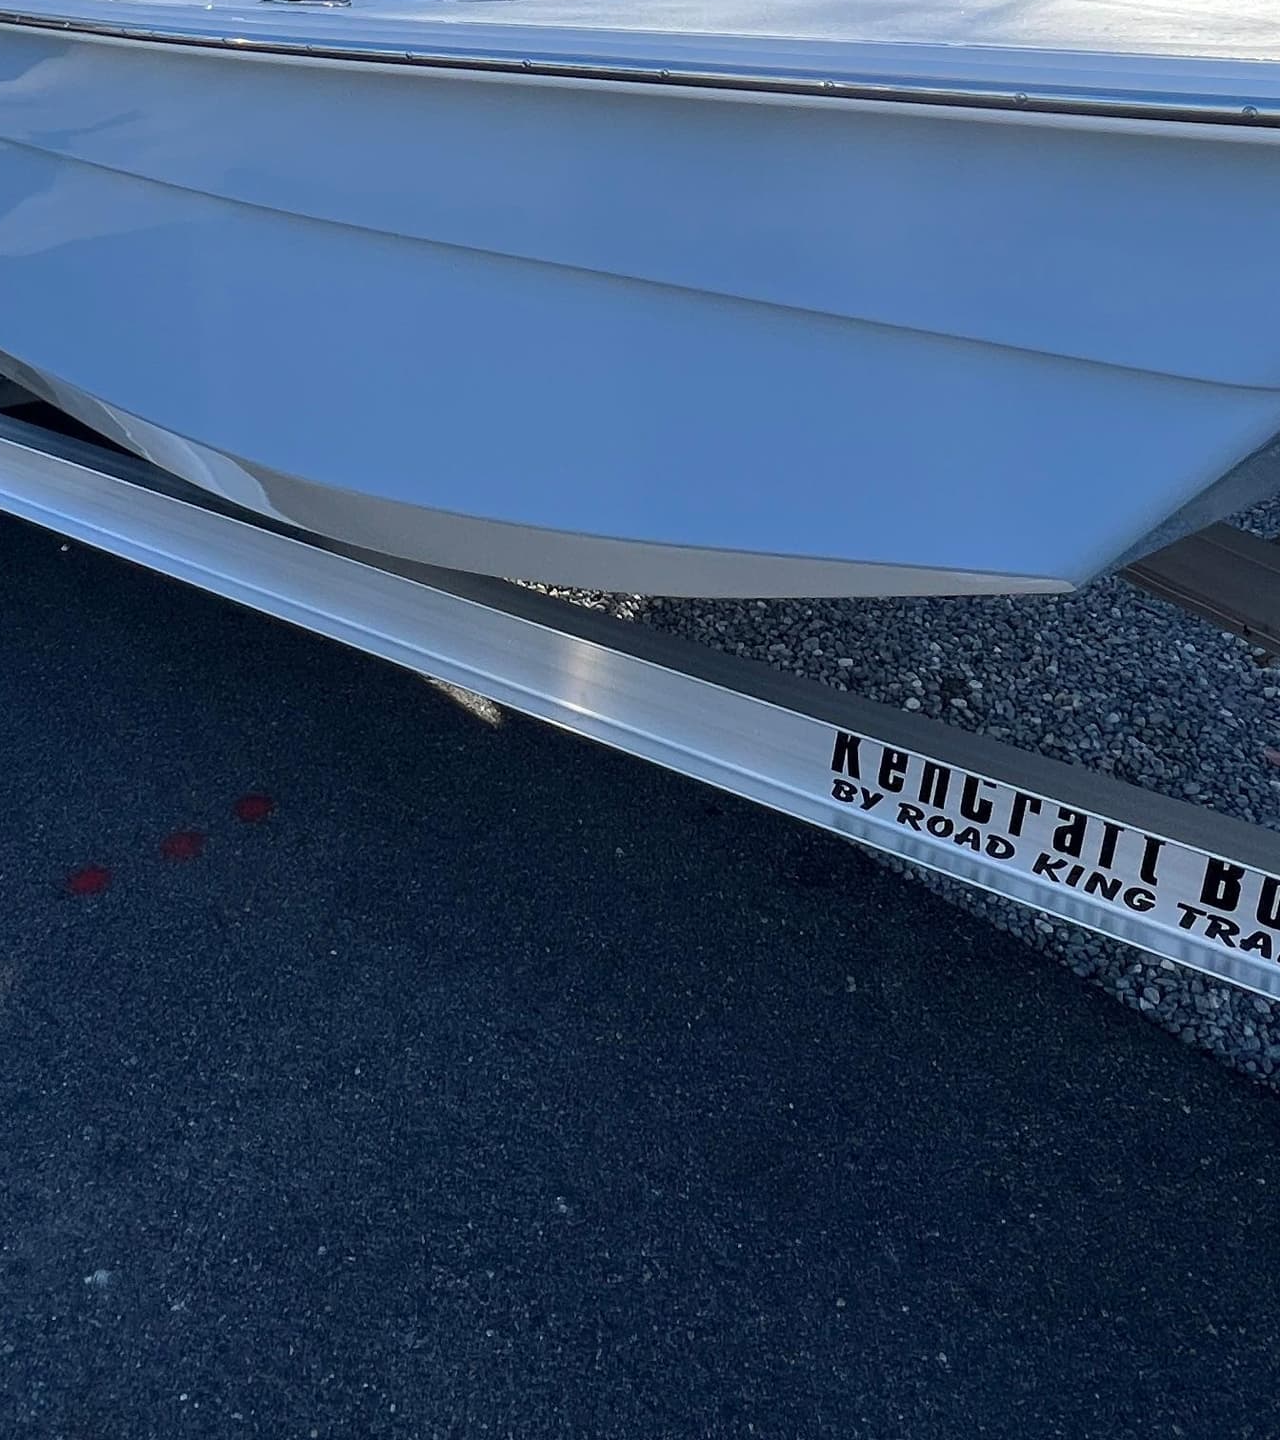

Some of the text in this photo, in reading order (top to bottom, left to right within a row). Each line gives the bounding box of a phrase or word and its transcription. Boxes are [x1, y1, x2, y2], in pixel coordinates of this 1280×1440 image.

[831, 778, 883, 811] BY
[896, 802, 1016, 860] ROAD
[1032, 852, 1157, 912] KING
